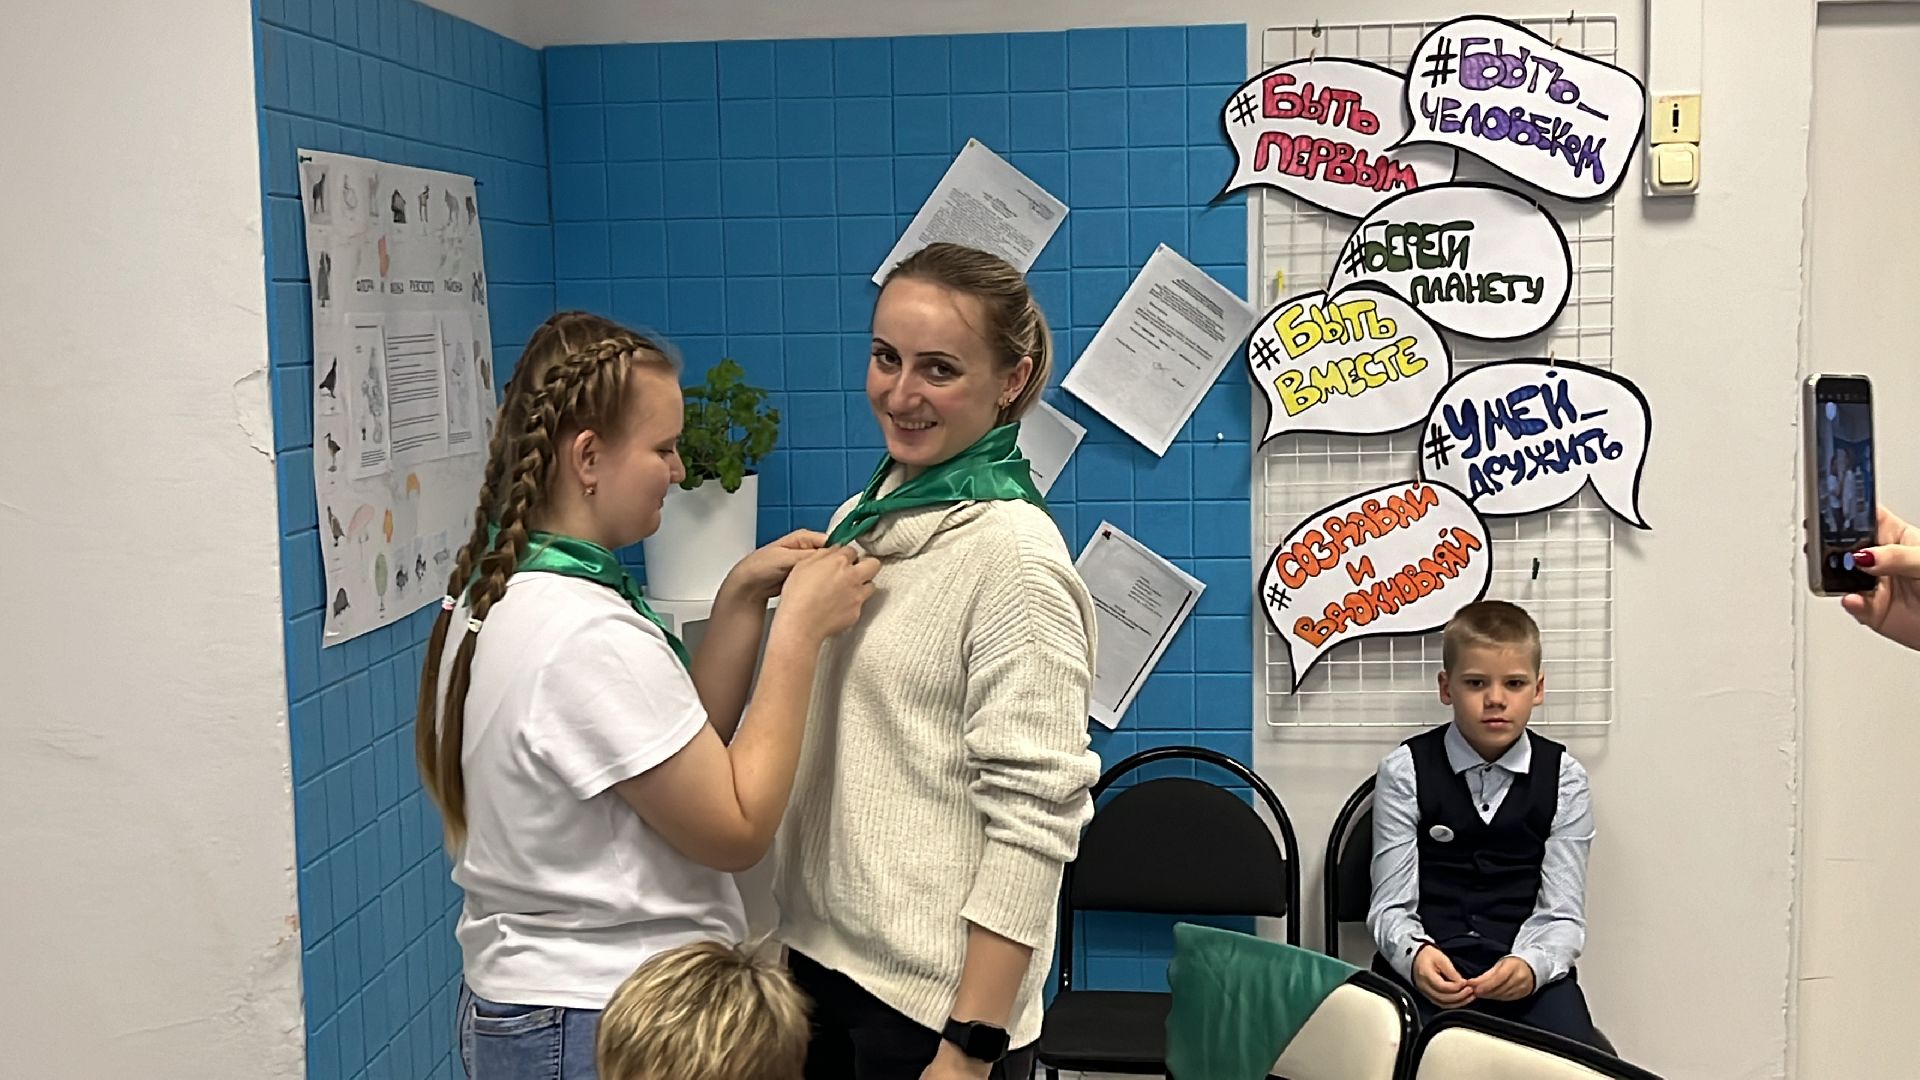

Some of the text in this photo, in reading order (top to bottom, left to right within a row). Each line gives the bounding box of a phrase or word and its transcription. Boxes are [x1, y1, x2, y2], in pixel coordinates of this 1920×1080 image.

[1229, 73, 1380, 135] #БЫТЬ
[1420, 91, 1606, 185] ЧЕЛОВЕКОМ
[1253, 131, 1419, 192] ПЕРВЫМ
[1342, 219, 1475, 278] #БЕРЕГИ
[1410, 272, 1544, 307] ПЛАНЕТУ
[1251, 299, 1397, 371] #БЫТЬ
[1273, 336, 1429, 417] ВМЕСТЕ
[1468, 427, 1624, 501] ДРУЖИТЬ
[1266, 481, 1440, 611] #СОЗДАВАЙ
[1345, 555, 1376, 586] И
[1292, 526, 1483, 649] ВДОХНОВЛЯЙ
